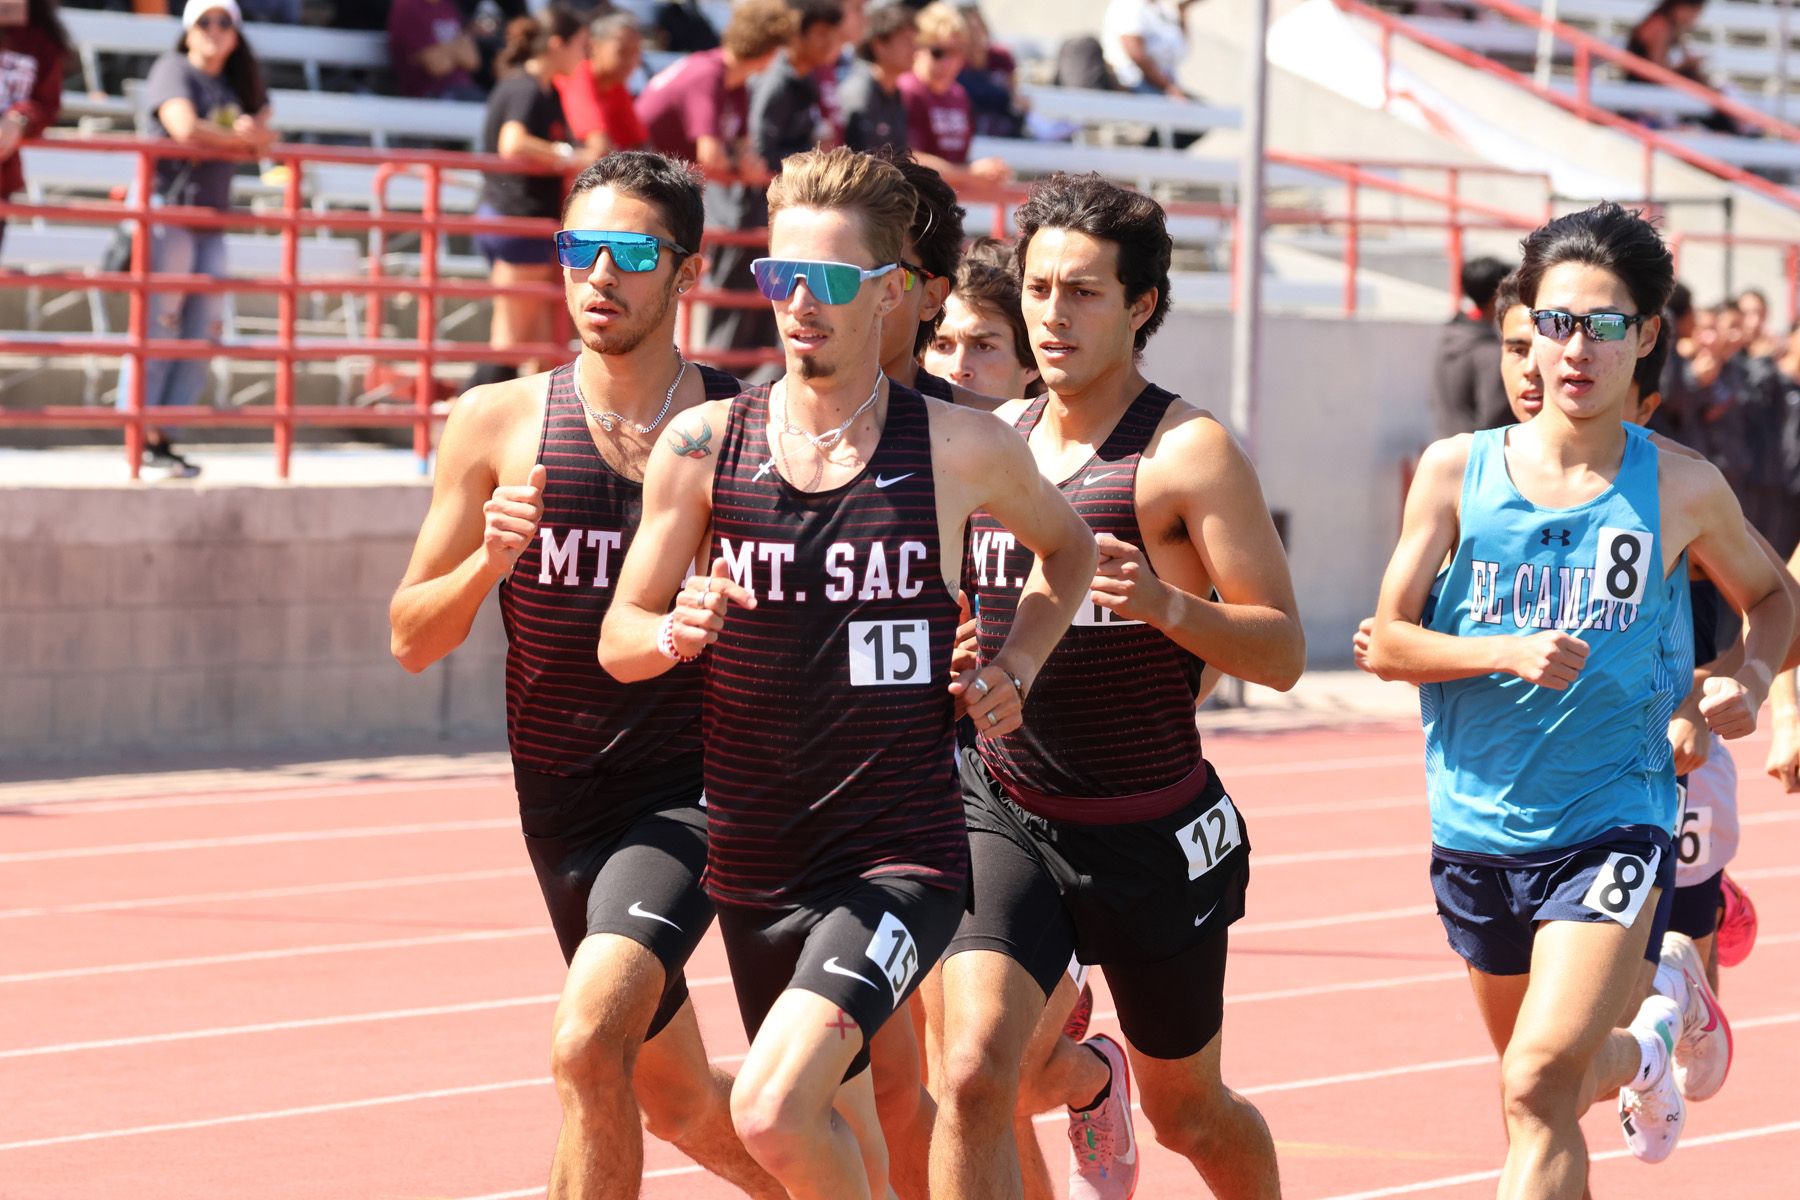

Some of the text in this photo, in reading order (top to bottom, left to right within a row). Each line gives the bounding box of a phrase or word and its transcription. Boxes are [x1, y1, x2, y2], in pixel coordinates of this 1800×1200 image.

[720, 537, 806, 602] MT.
[825, 540, 927, 602] SAC
[1469, 559, 1504, 625] EL
[1606, 534, 1641, 599] 8
[863, 624, 918, 681] 15
[1191, 807, 1232, 868] 12
[1599, 855, 1645, 914] 8
[884, 929, 917, 994] 15
